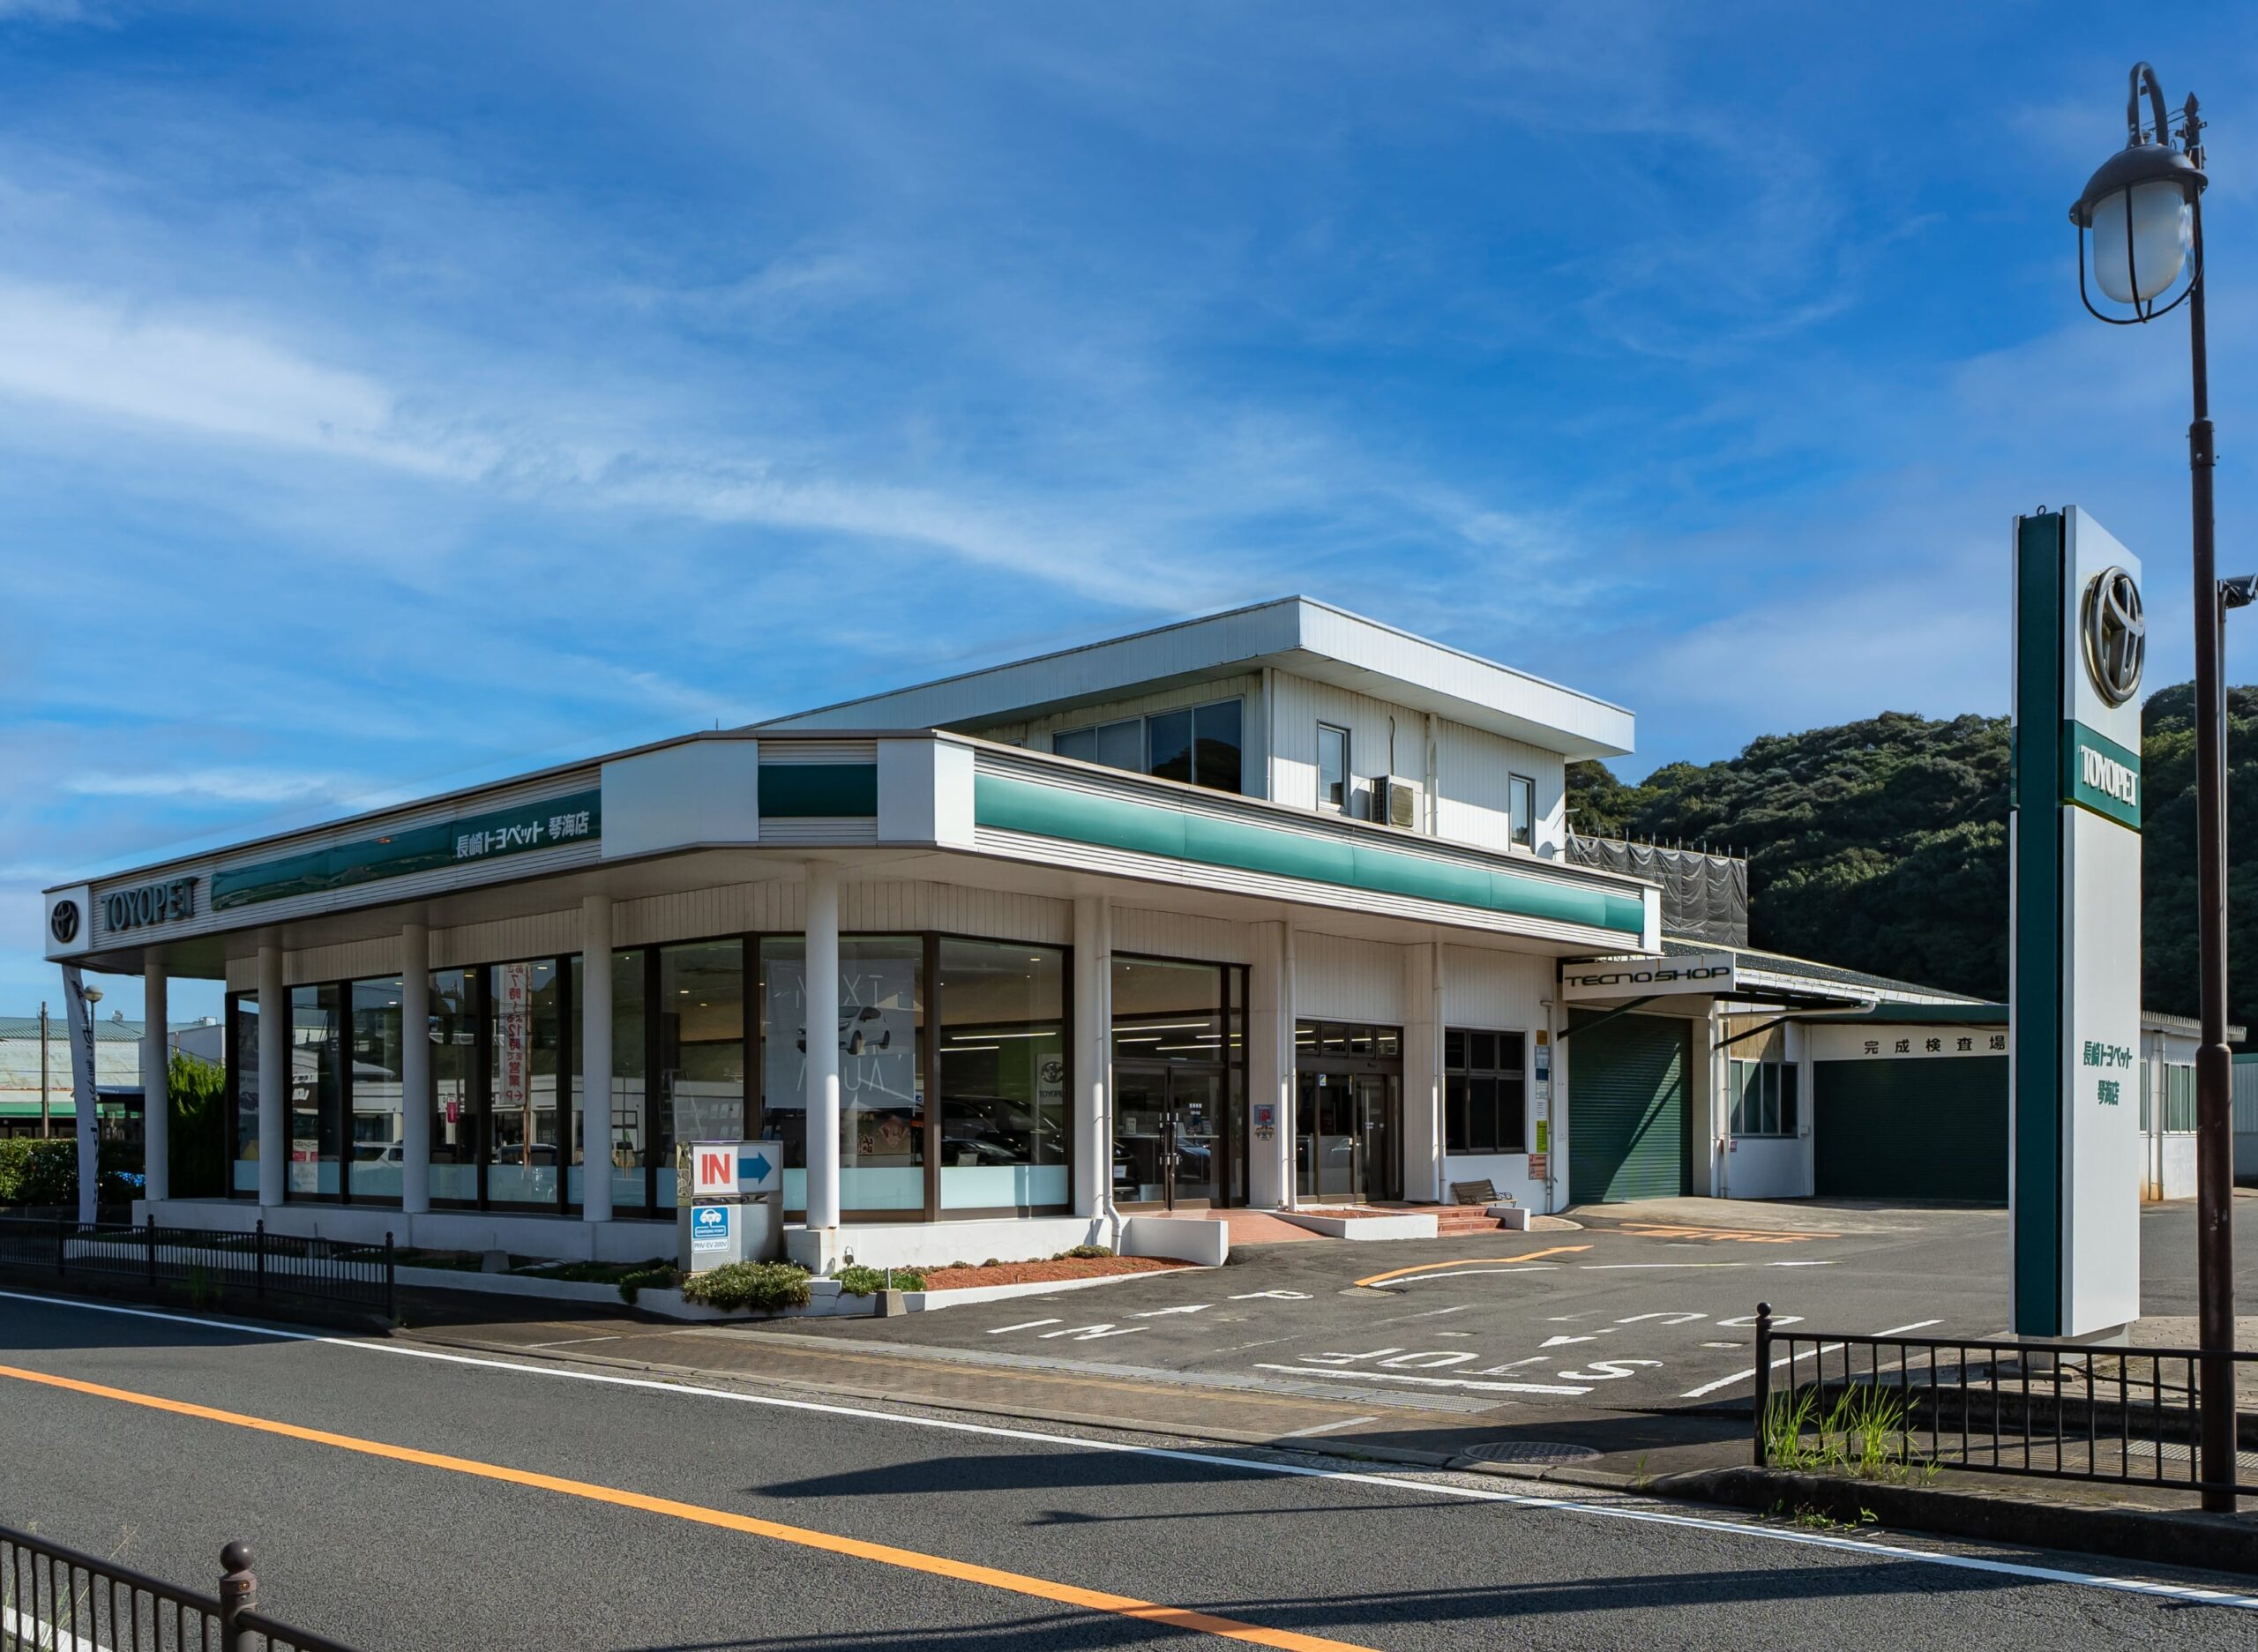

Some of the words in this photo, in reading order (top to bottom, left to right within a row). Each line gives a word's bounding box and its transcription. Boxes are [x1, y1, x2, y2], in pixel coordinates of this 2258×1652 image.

[2078, 744, 2138, 807] TOYOPET
[456, 820, 544, 858] 長崎トヨペット
[549, 811, 590, 840] 琴海店
[101, 877, 199, 931] TOYOPET
[797, 974, 883, 1008] NXT
[1864, 1035, 2006, 1055] 完成検査場
[2083, 1041, 2133, 1070] 長崎トヨペット
[2097, 1080, 2120, 1106] 琴海店
[701, 1154, 730, 1185] IN
[986, 1319, 1150, 1341] IN
[1297, 1346, 1664, 1380] STOP
